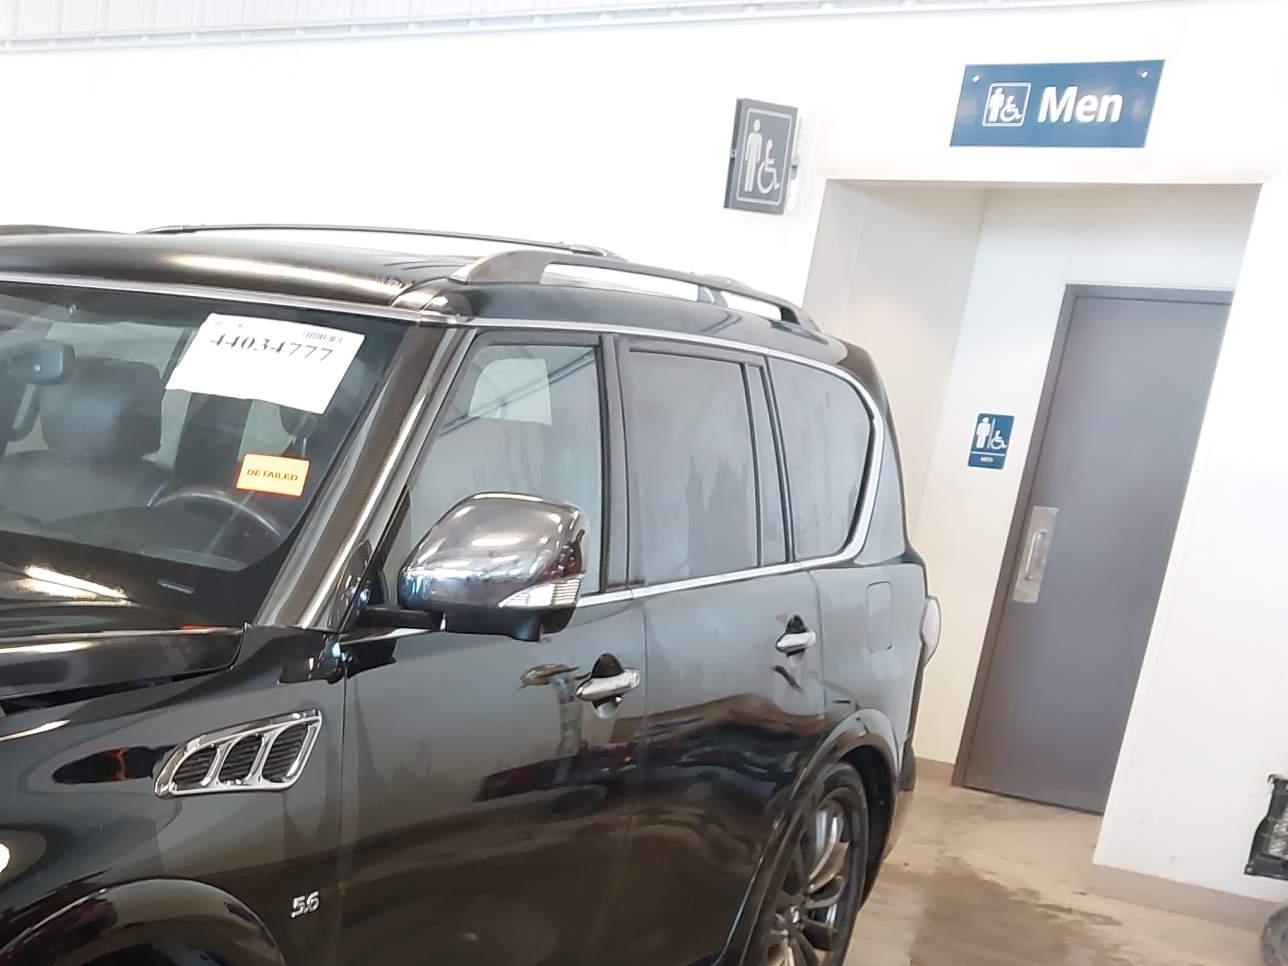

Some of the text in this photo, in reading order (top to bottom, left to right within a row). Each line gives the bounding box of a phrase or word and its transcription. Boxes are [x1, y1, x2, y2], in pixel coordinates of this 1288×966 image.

[1037, 86, 1123, 123] Men
[210, 333, 333, 361] 44034777
[246, 468, 298, 481] DETAILED
